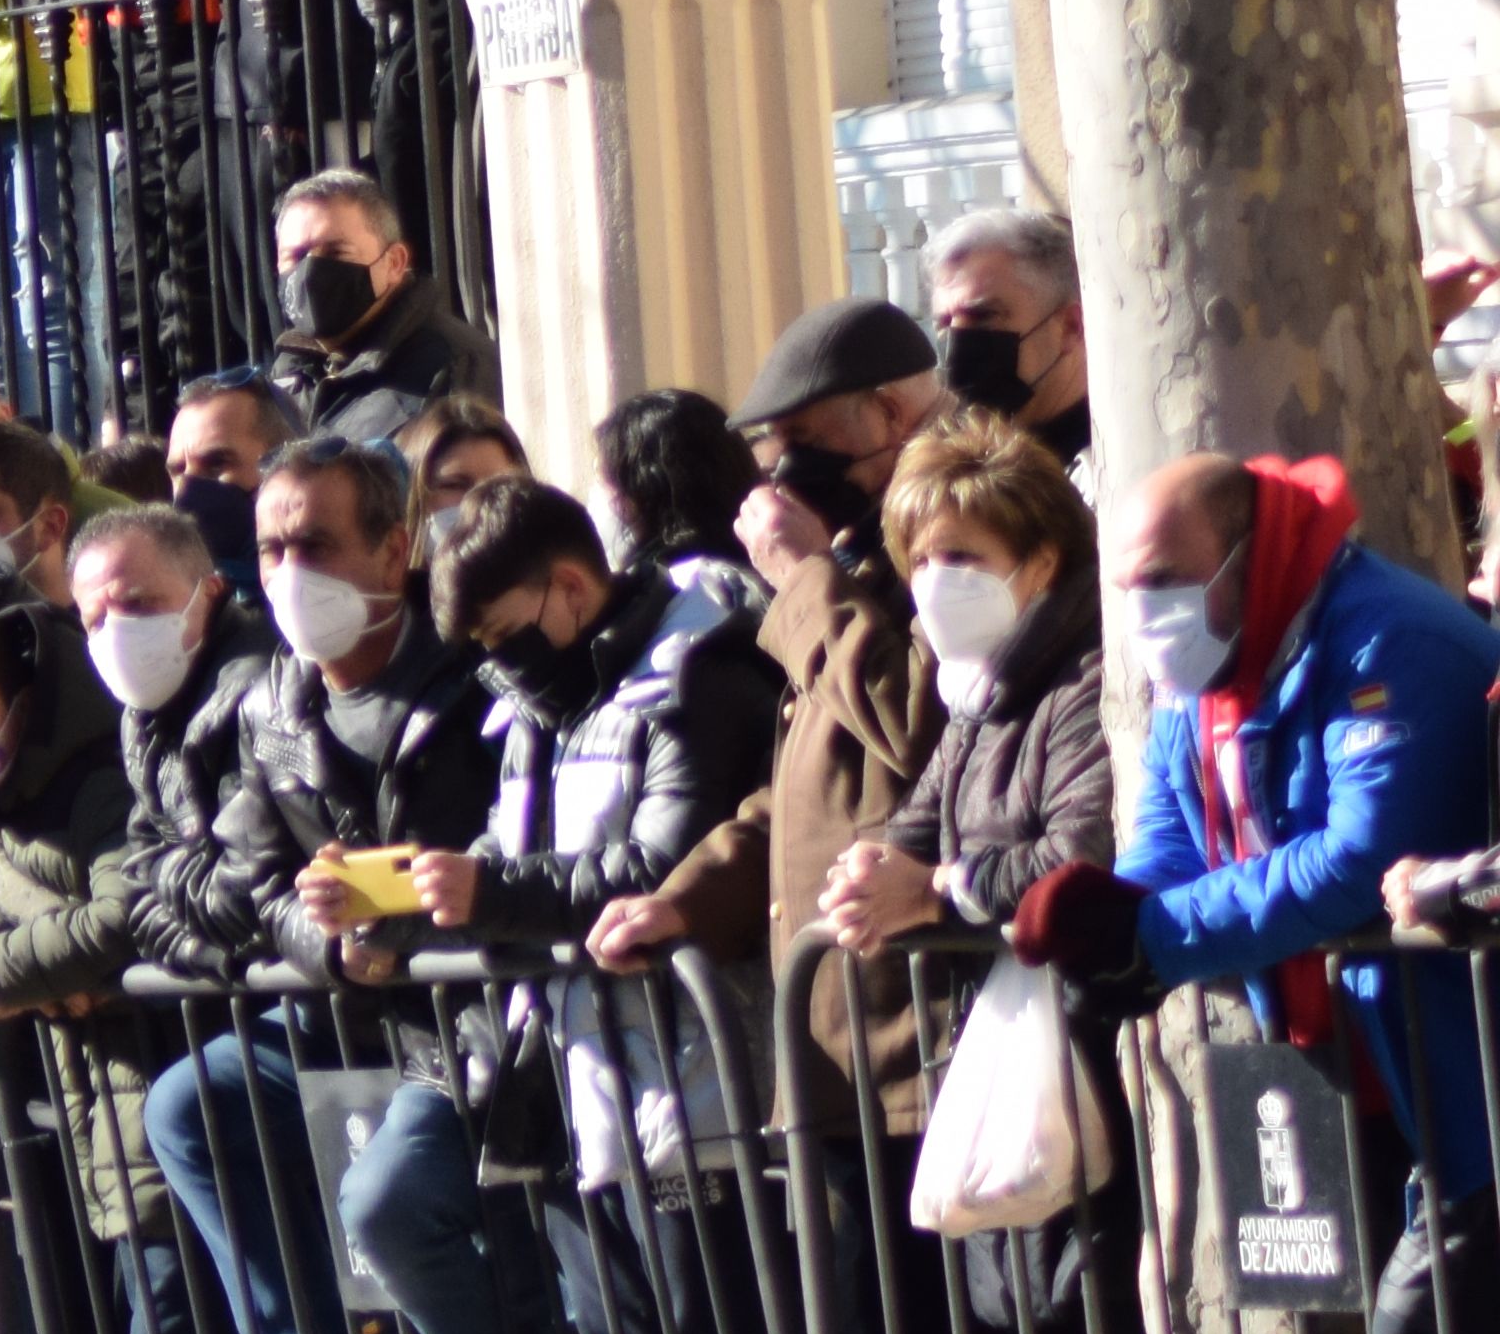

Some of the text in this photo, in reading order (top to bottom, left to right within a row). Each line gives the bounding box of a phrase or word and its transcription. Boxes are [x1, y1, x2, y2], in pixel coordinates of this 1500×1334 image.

[1238, 1217, 1332, 1241] AYUNTAMIENTO
[1239, 1242, 1336, 1276] DE ZAMORA
